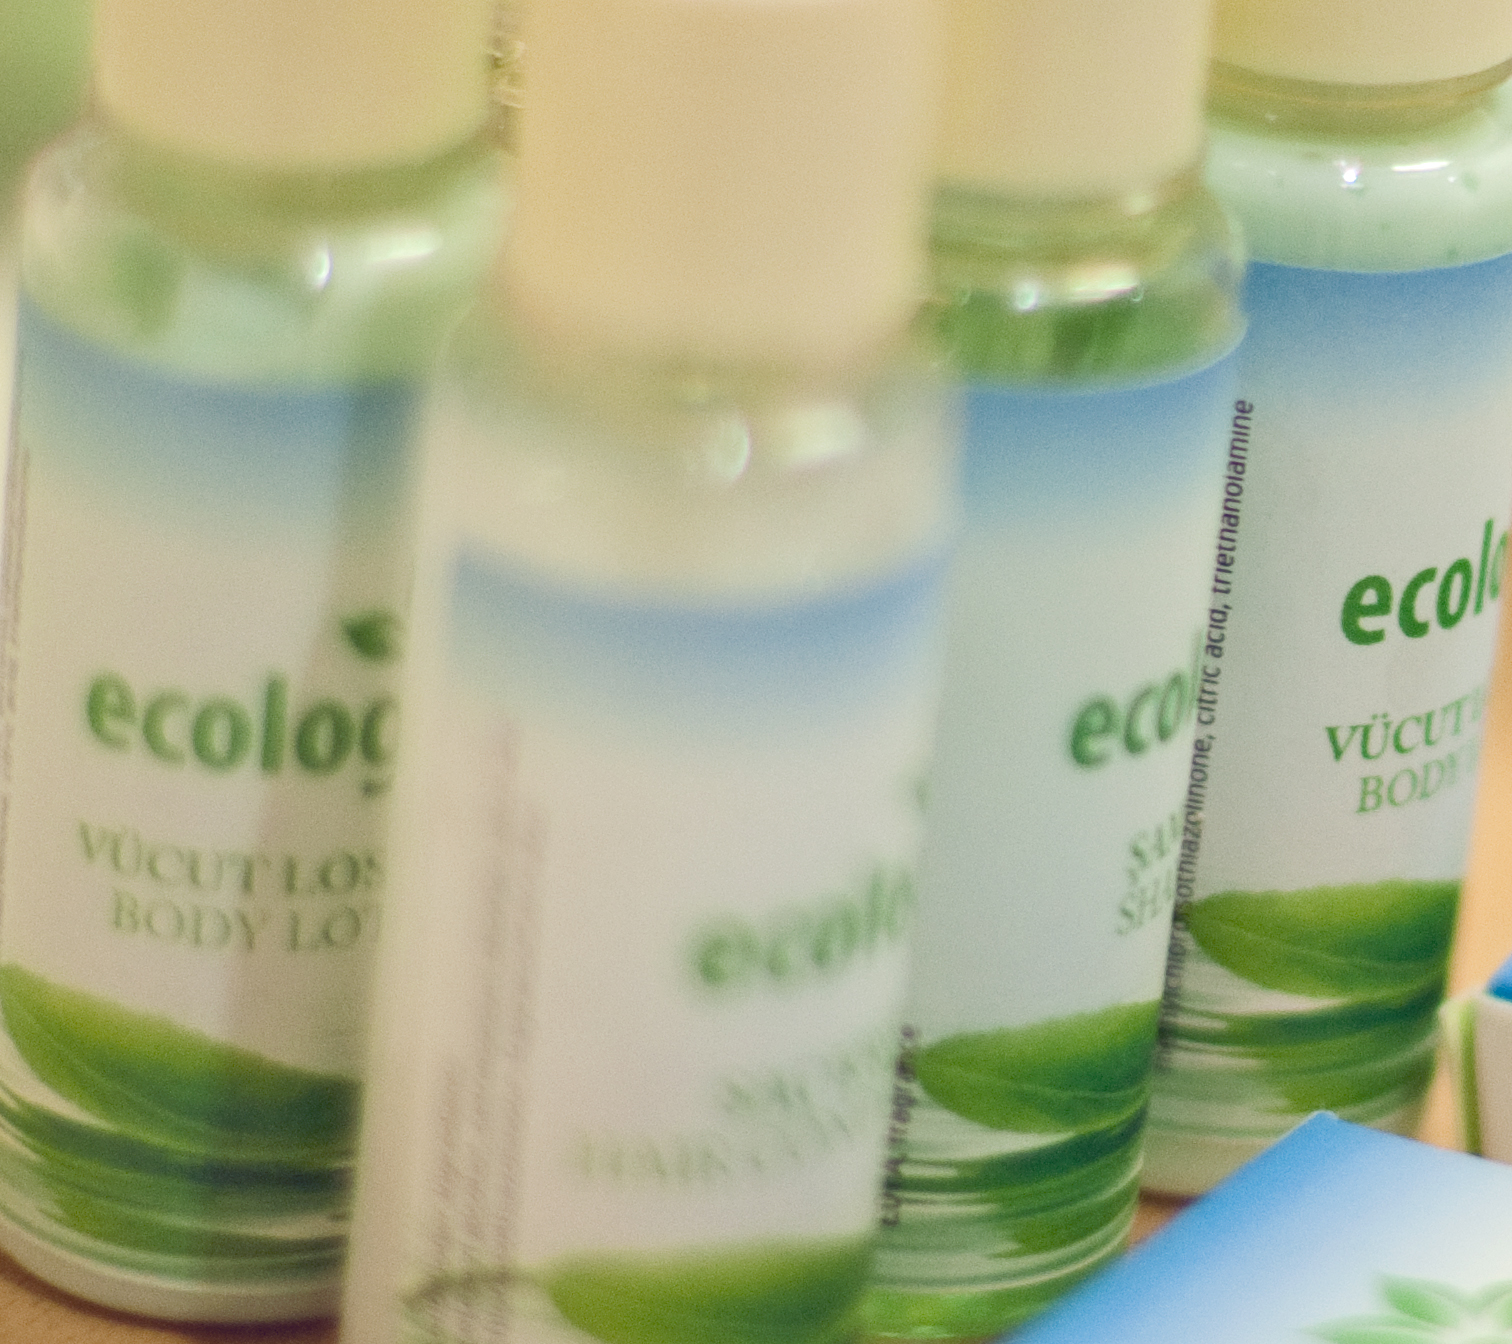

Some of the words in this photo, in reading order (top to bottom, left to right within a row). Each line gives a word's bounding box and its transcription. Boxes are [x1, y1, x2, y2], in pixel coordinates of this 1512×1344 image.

[1211, 399, 1254, 595] triethanolamine
[1205, 606, 1233, 659] acid,
[1197, 665, 1221, 726] citric
[1324, 693, 1474, 763] VÜCUT
[75, 817, 274, 896] VÜCUT
[110, 887, 274, 950] BODY
